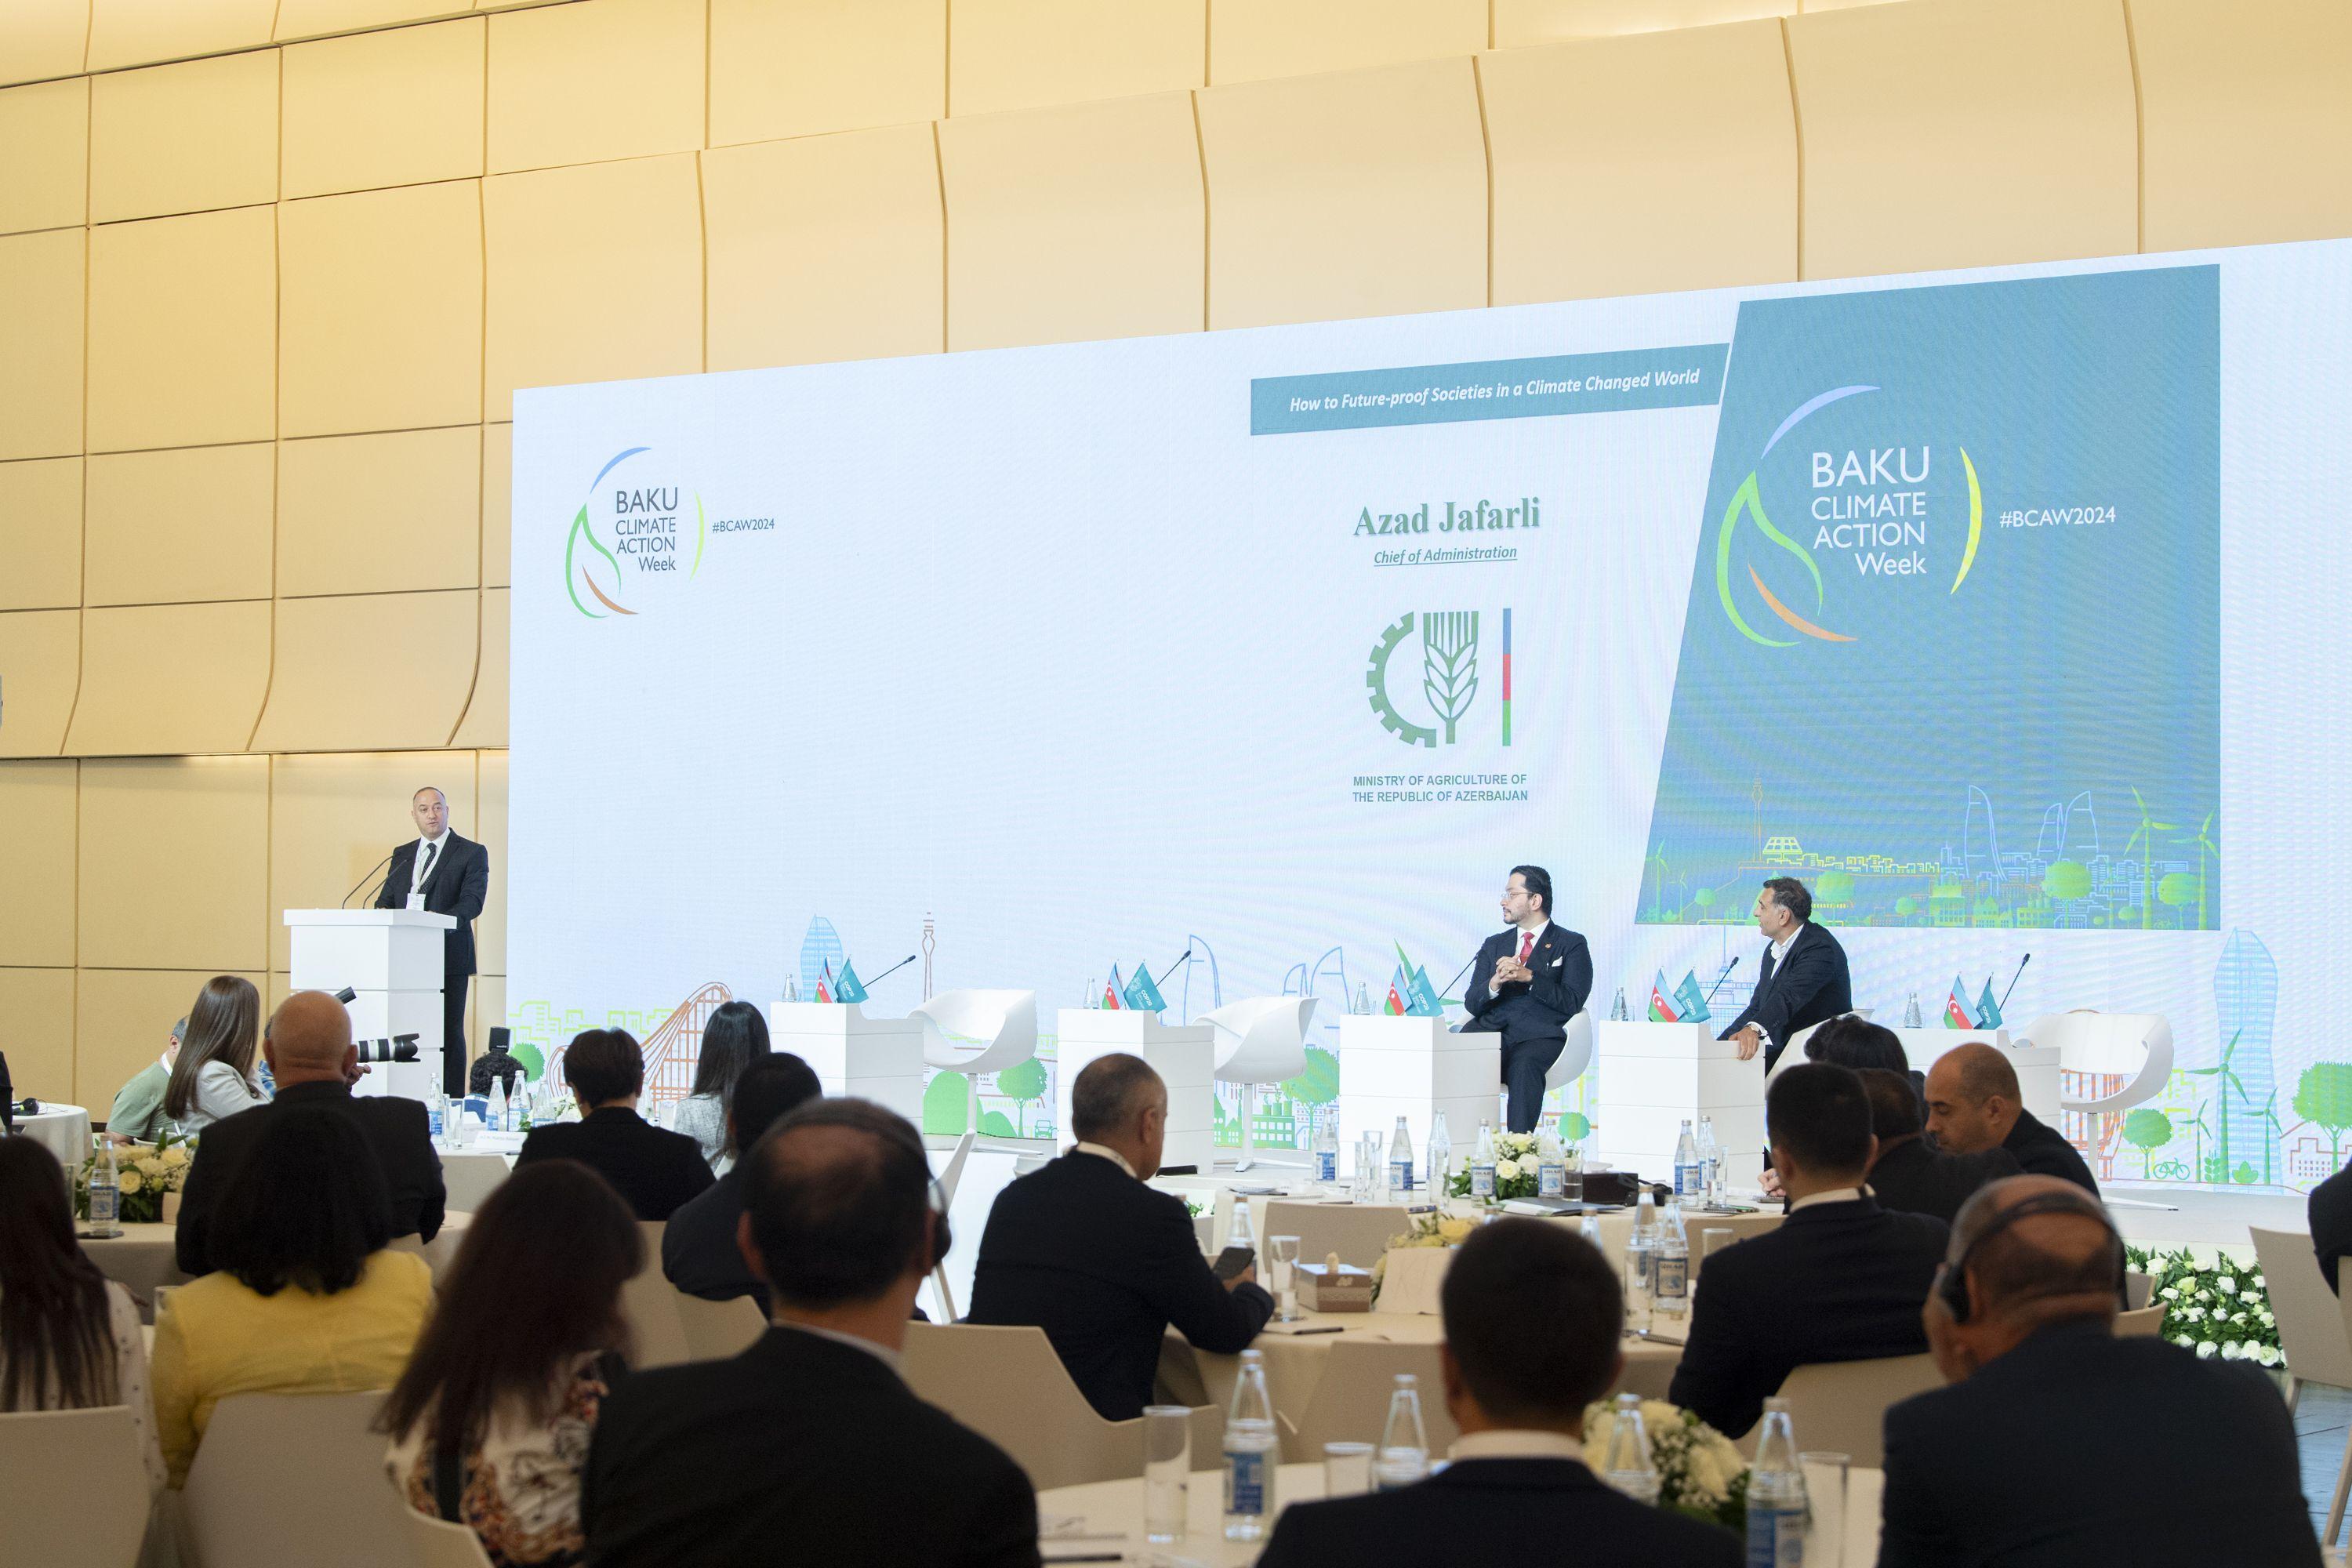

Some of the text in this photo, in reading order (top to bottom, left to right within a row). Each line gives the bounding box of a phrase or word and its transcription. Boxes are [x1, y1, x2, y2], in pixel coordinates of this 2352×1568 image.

[1290, 368, 1700, 412] How to Future-proof Societies in a Climate Changed World
[1812, 445, 1929, 488] BAKU
[615, 486, 679, 514] BAKU
[1811, 491, 1926, 521] CLIMATE
[615, 517, 677, 535] CLIMATE
[712, 518, 775, 534] #BCAW2024
[1353, 496, 1540, 536] Azad Jafarli
[1999, 506, 2117, 528] #BCAW2024
[616, 536, 676, 554] ACTION
[1813, 521, 1926, 550] ACTION
[638, 555, 677, 572] Week
[1374, 546, 1518, 565] Chief of Administration
[1854, 550, 1927, 576] Week
[1353, 774, 1527, 786] MINISTRY OF AGRICULTURE OF
[1352, 790, 1528, 802] THE REPUBLIC OF AZERBAIJAN
